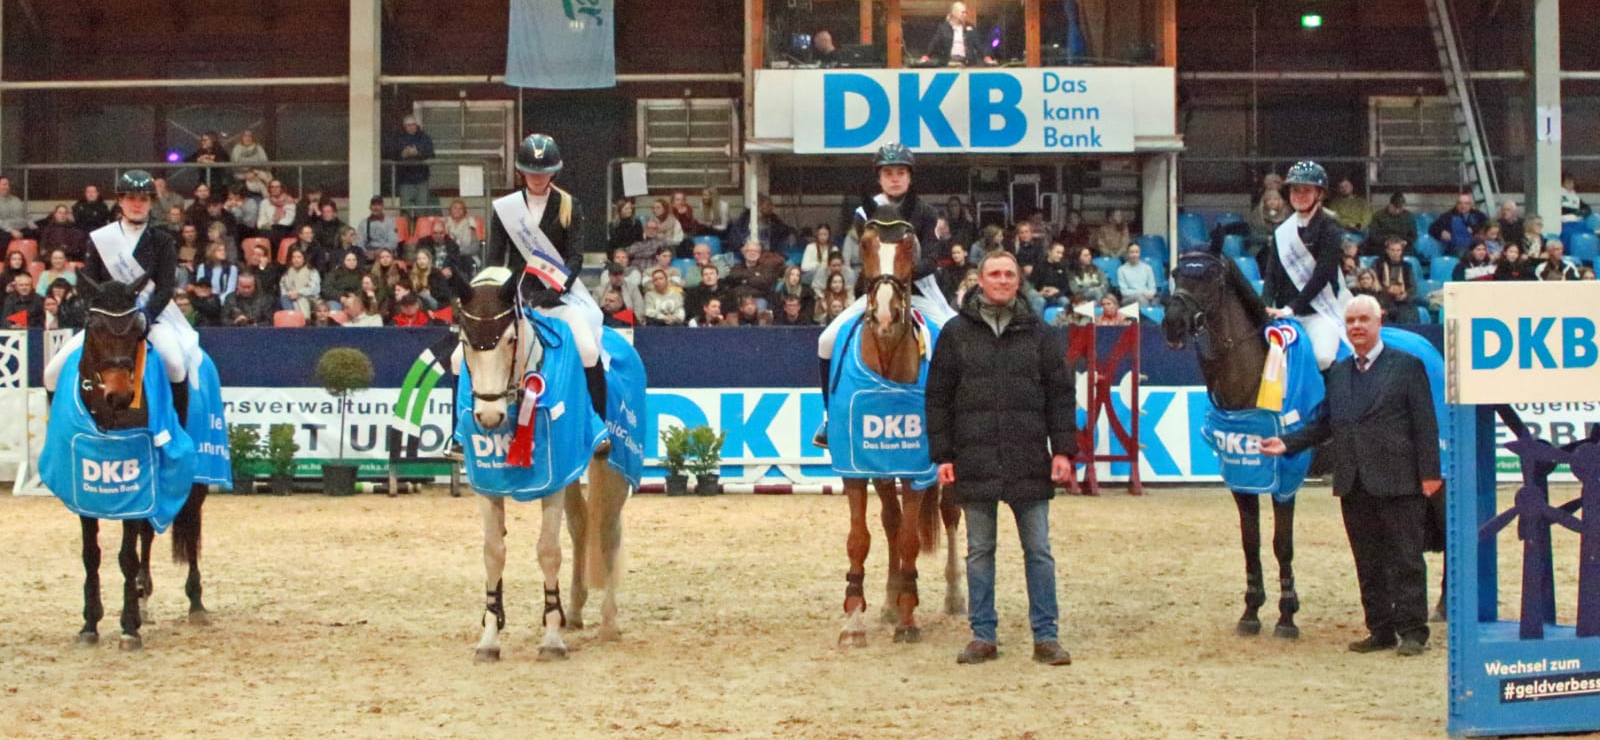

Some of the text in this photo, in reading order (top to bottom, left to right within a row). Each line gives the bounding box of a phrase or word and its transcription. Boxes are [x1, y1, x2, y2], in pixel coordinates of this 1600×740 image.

[1043, 73, 1087, 93] Das
[824, 73, 1028, 148] DKB
[1043, 100, 1100, 120] kann
[1044, 127, 1102, 148] Bank
[1471, 317, 1599, 370] DKB
[863, 414, 922, 439] DKB
[471, 433, 535, 457] DK
[82, 458, 141, 483] DKB
[1484, 658, 1581, 677] Wechsel zum
